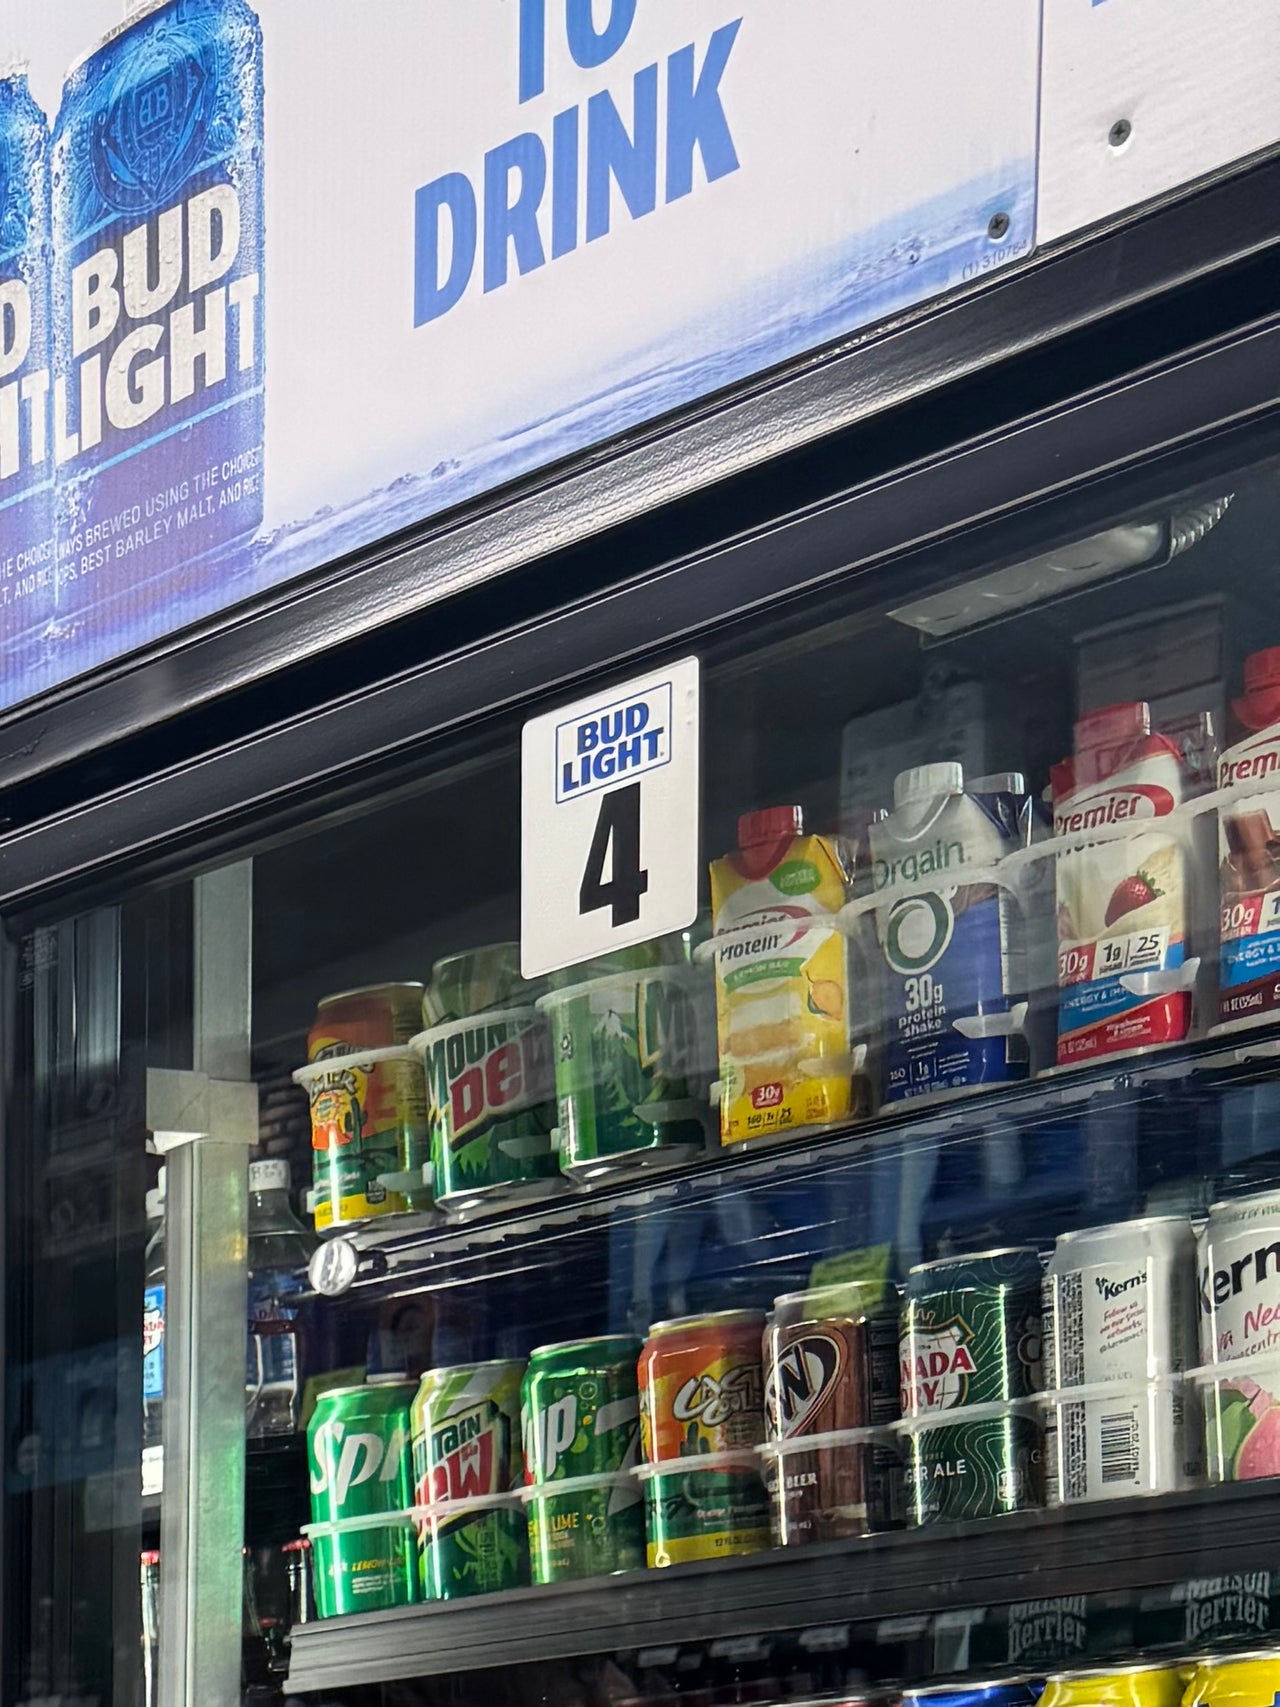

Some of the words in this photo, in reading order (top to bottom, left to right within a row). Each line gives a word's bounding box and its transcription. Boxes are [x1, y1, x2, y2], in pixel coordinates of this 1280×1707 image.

[514, 0, 637, 104] TO
[414, 16, 744, 329] DRINK
[72, 184, 241, 355] BUD
[55, 273, 258, 464] LIGHT
[81, 546, 111, 575] BEST
[116, 521, 171, 557] BARLEY
[219, 484, 241, 508] AND
[85, 505, 141, 543] BREWED
[145, 482, 189, 517] USING
[194, 467, 218, 494] THE
[577, 702, 649, 756] BUD
[563, 727, 664, 793] LIGHT
[1055, 794, 1142, 840] Premier
[579, 782, 648, 928] 4
[1059, 951, 1090, 981] 30g
[1103, 941, 1123, 966] 1g
[1137, 932, 1160, 955] 25
[899, 1003, 948, 1031] protein
[904, 973, 943, 1014] 30g
[904, 1016, 943, 1040] shake
[1104, 1271, 1148, 1300] Kern's
[934, 1459, 968, 1479] ALE
